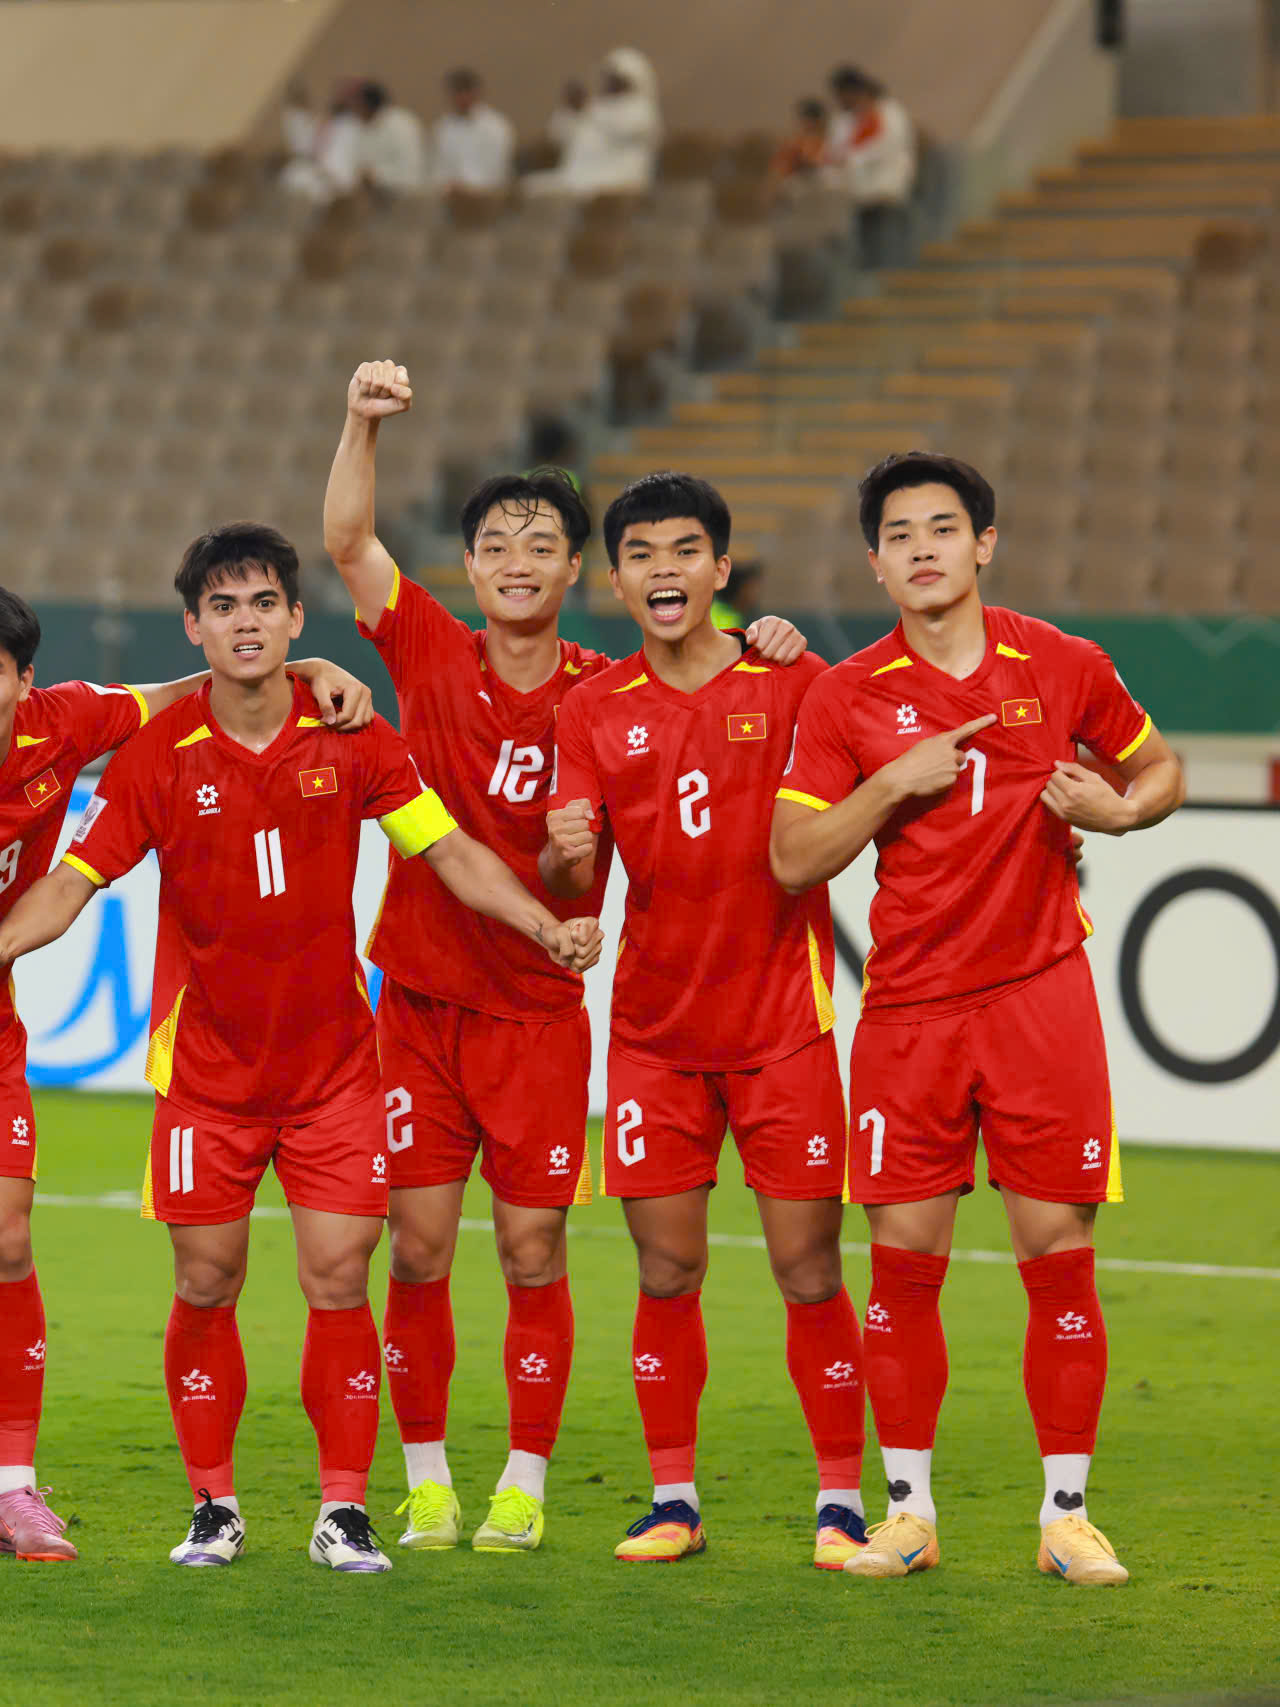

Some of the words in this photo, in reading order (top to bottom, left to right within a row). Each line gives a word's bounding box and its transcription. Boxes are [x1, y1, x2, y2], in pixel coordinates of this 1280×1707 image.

[487, 739, 545, 803] 12
[677, 768, 711, 839] 2
[960, 747, 987, 817] 7
[253, 827, 286, 899] 11
[385, 1086, 414, 1154] 2
[616, 1098, 646, 1167] 2
[859, 1107, 886, 1177] 7
[169, 1125, 194, 1195] 11
